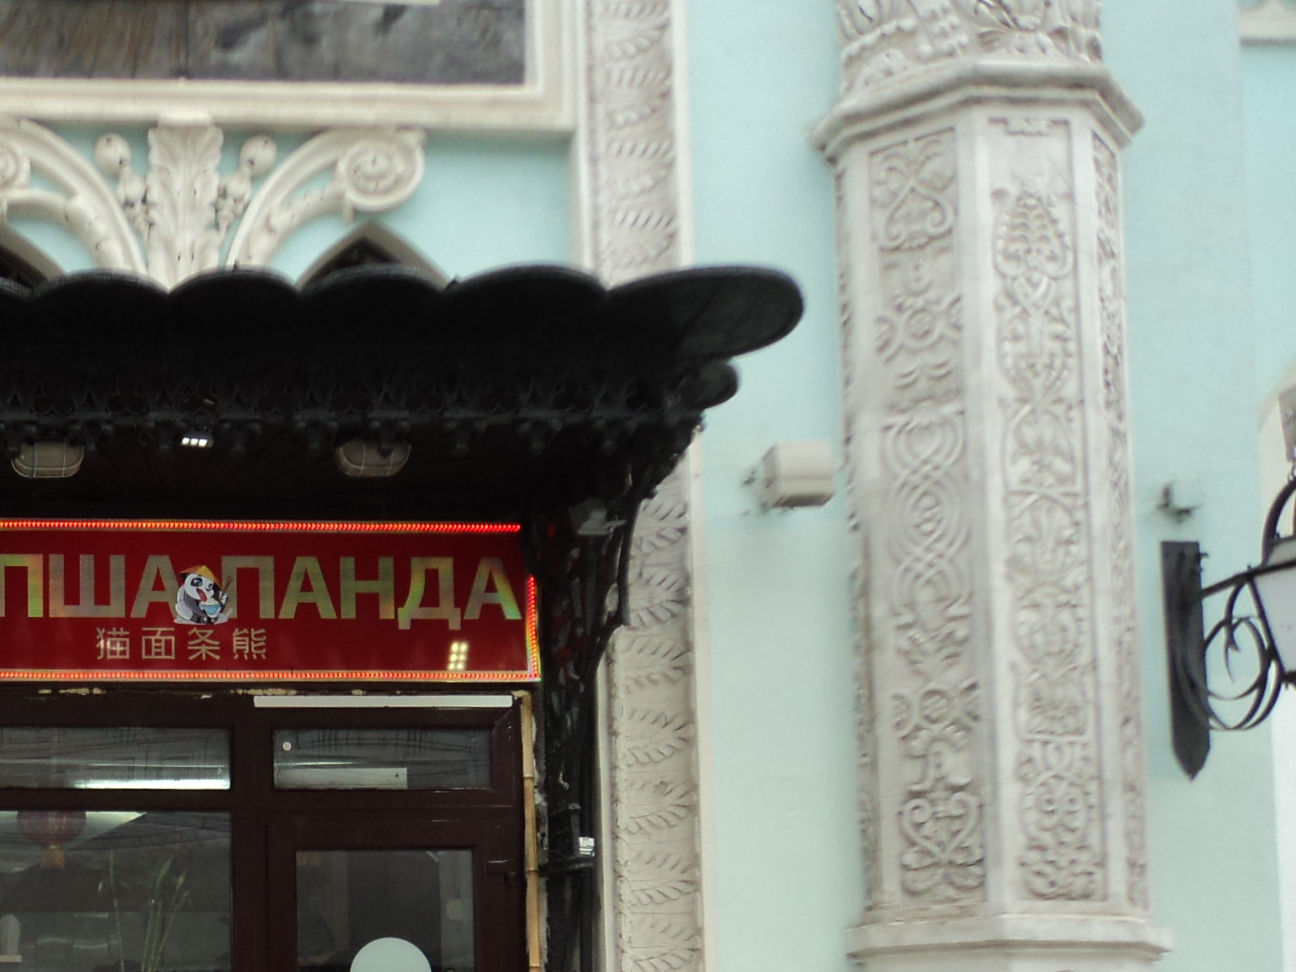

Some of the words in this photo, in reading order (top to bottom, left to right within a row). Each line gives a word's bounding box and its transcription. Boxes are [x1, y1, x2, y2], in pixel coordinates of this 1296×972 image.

[221, 555, 522, 630] ПАНДА
[96, 627, 267, 660] 猫面条熊
